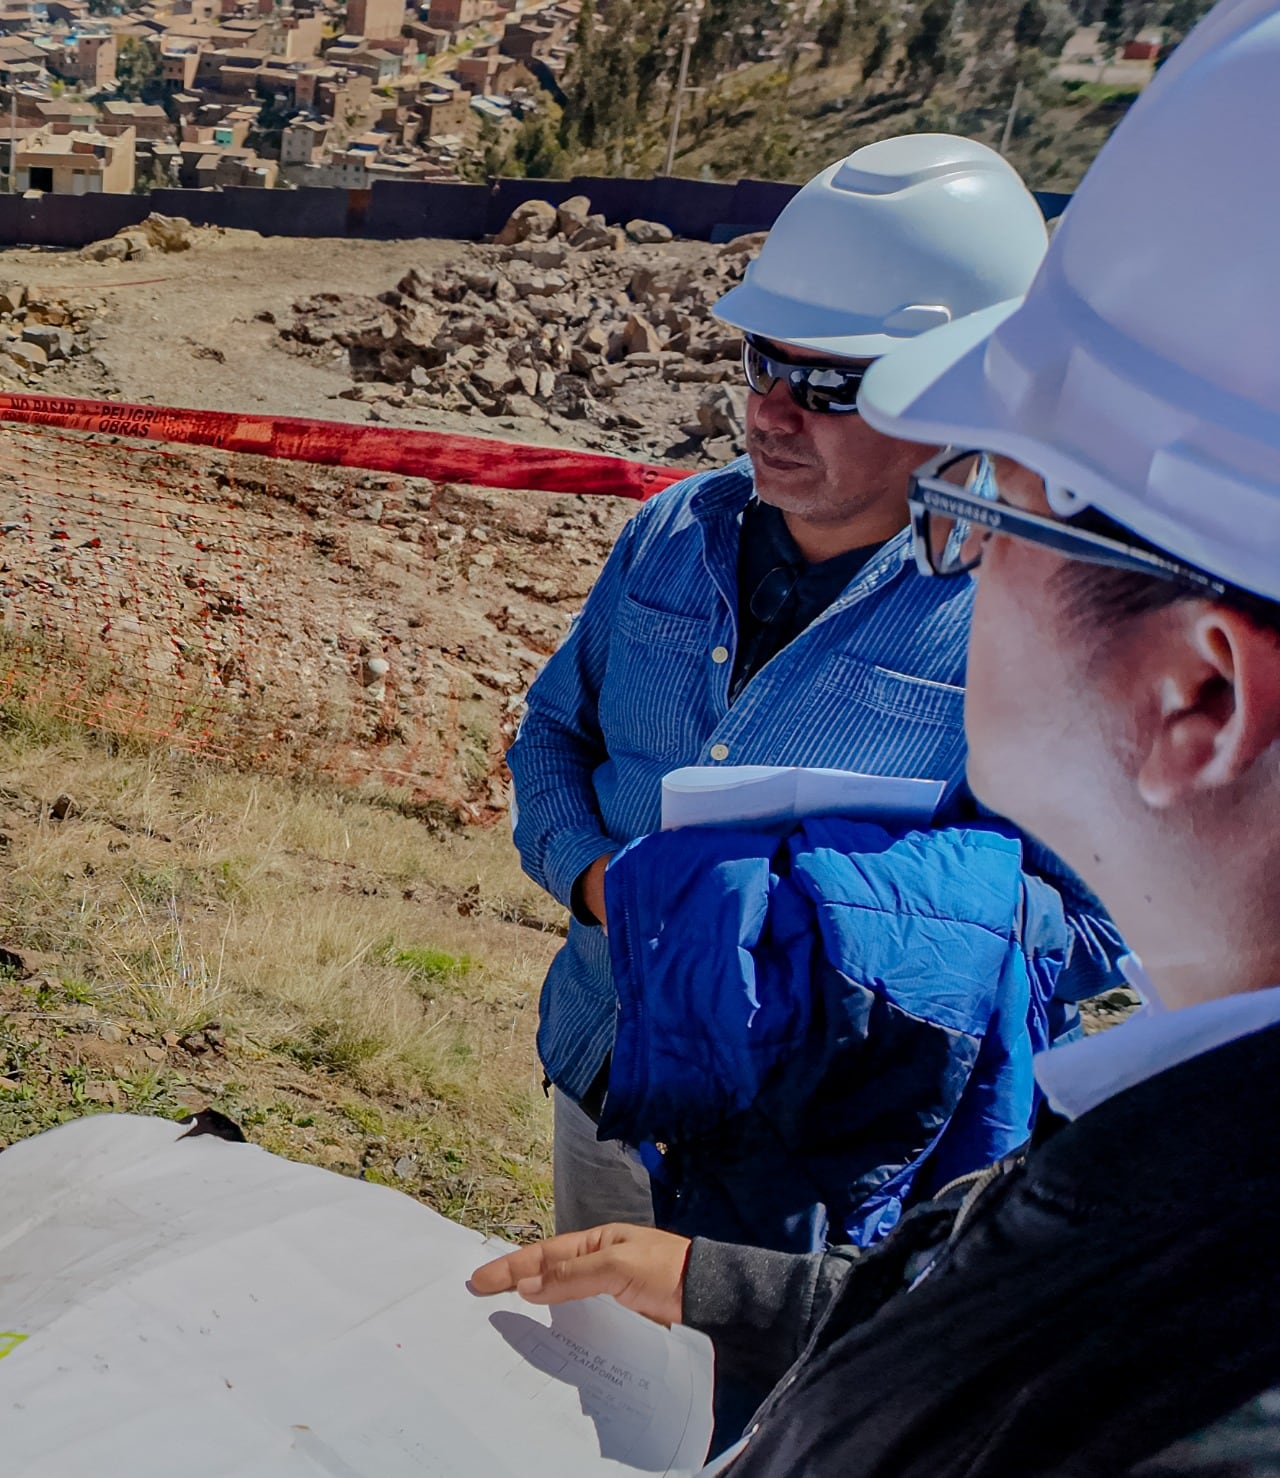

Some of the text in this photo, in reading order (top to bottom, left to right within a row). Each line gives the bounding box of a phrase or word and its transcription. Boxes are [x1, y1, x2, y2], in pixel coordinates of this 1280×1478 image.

[10, 397, 76, 415] NO PASAR
[98, 419, 151, 438] OBRAS
[923, 491, 988, 522] CONVERSE
[551, 1329, 589, 1357] LEYENDA
[593, 1355, 606, 1366] DE
[568, 1350, 625, 1387] PLATAFORMA
